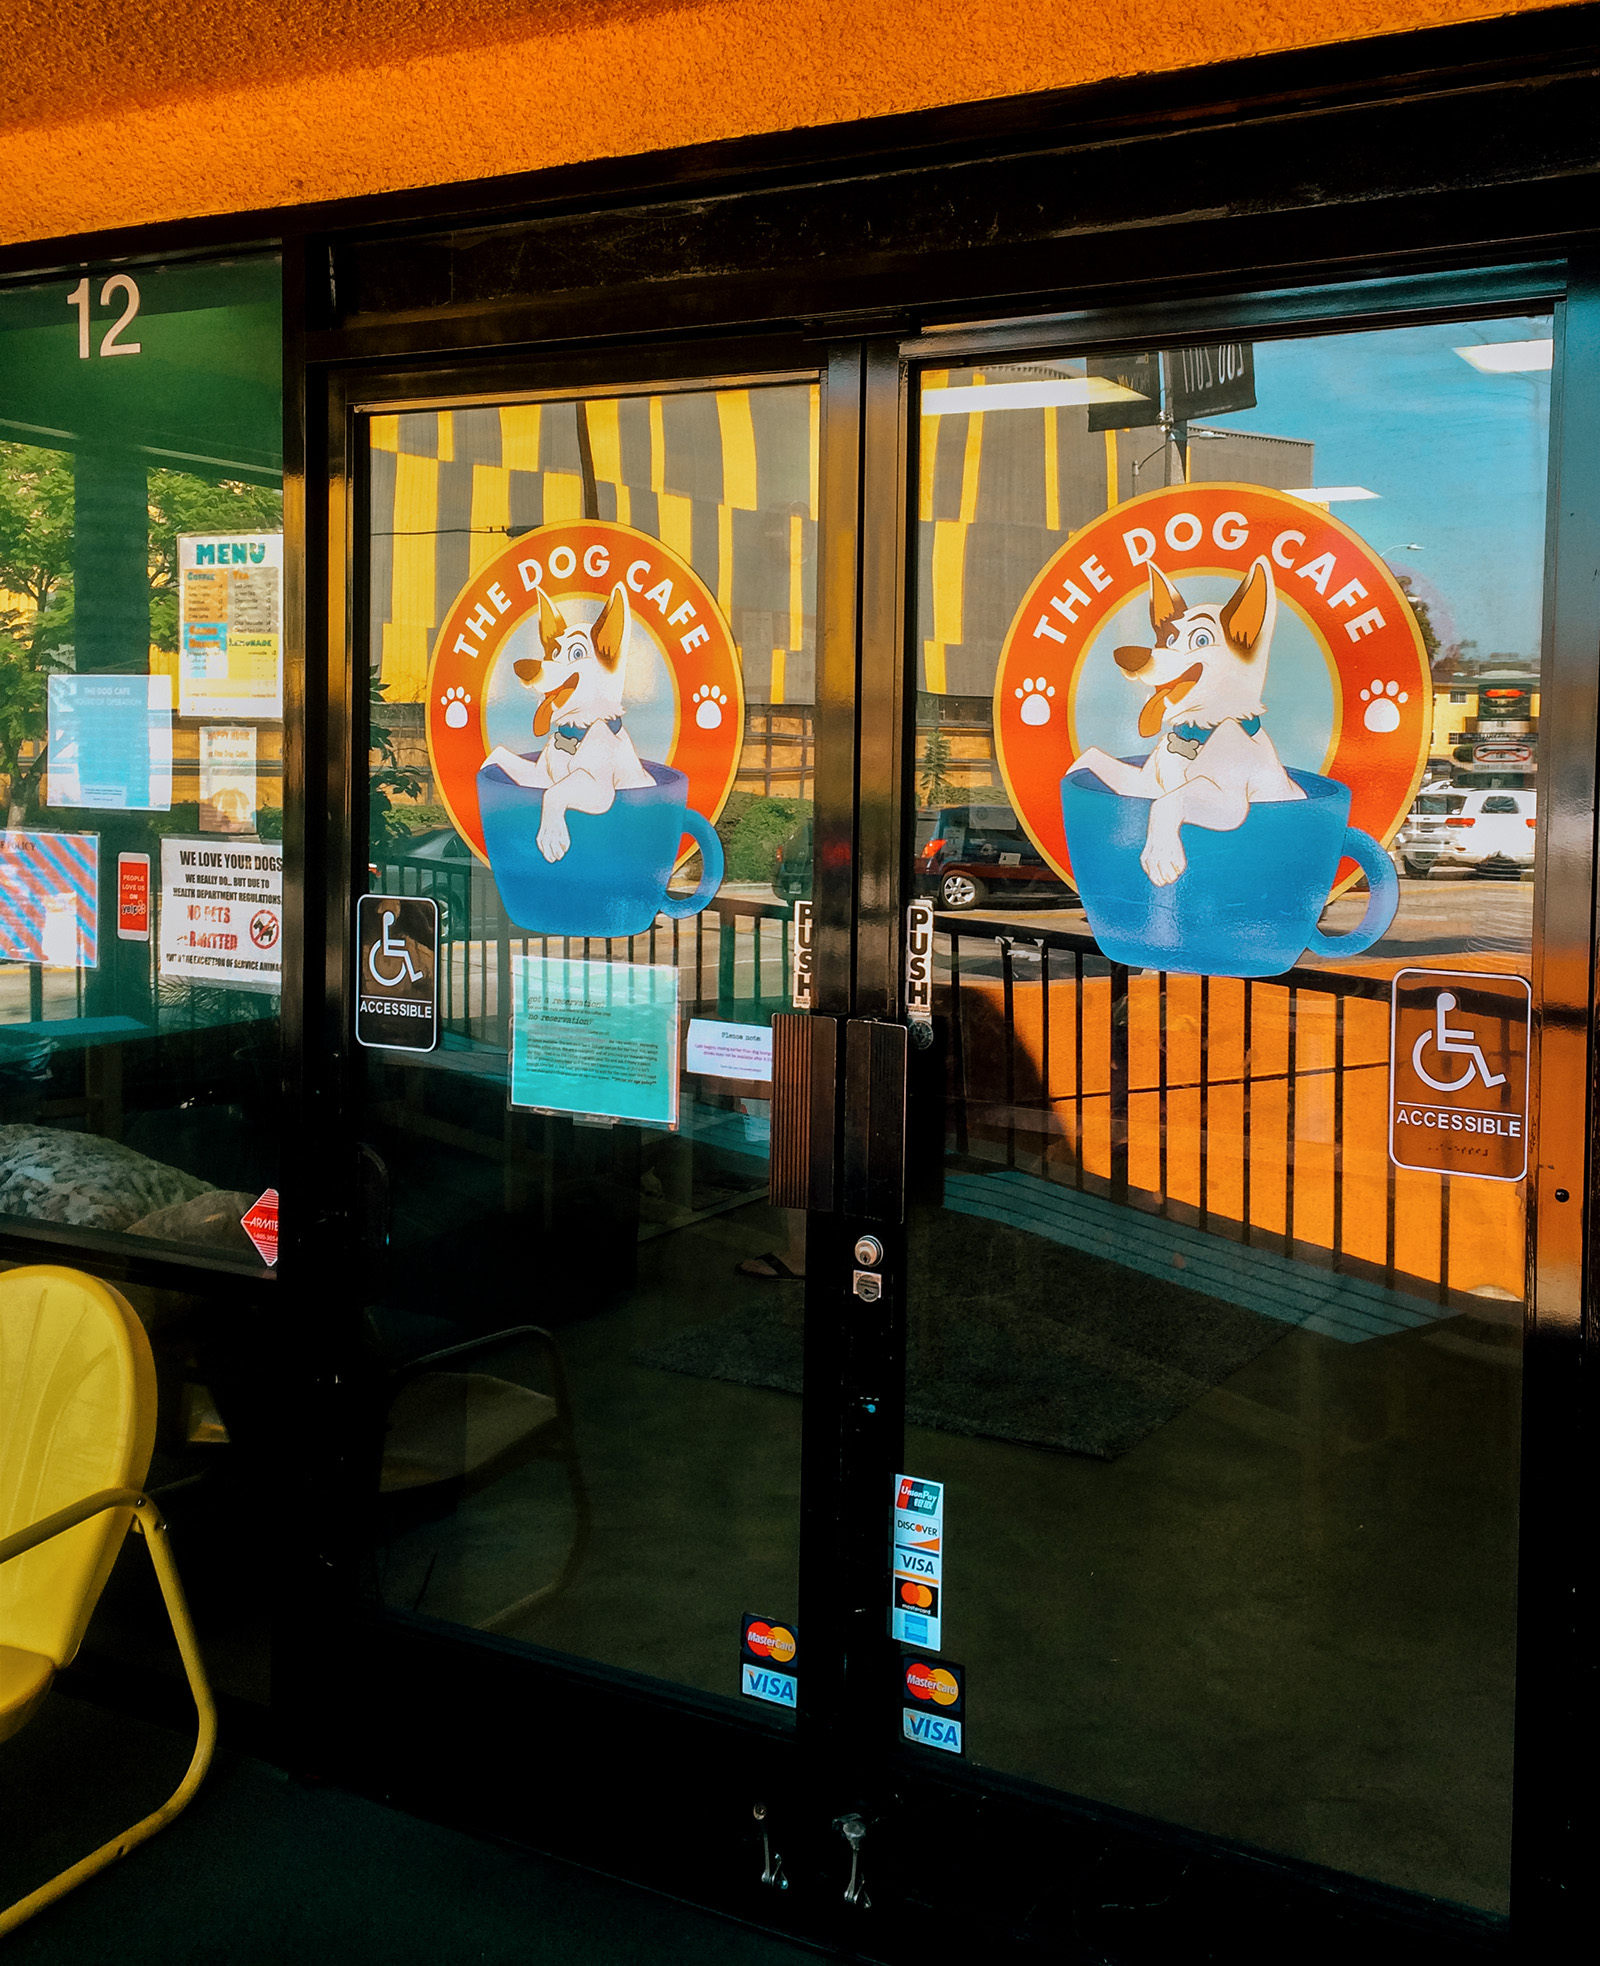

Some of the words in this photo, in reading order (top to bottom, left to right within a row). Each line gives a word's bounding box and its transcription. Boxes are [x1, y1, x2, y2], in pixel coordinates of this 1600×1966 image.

[67, 274, 141, 359] 12
[196, 543, 265, 565] MENU
[1032, 553, 1114, 646] THE
[1122, 511, 1249, 567] DOG
[1271, 529, 1387, 643] CAFE
[452, 581, 513, 660] THE
[517, 544, 610, 590] DOG
[625, 559, 711, 656] CAFE
[180, 851, 196, 866] WE
[198, 852, 222, 868] LOVE
[224, 854, 252, 870] YOUR
[254, 856, 283, 872] DOGS
[123, 874, 145, 882] PEOPLE
[185, 873, 196, 884] WE
[197, 874, 217, 885] REALLY
[233, 877, 246, 888] BUT
[248, 878, 260, 888] DUE
[261, 879, 270, 889] TO
[173, 887, 195, 898] HEALTH
[197, 889, 237, 901] DEPARTMENT
[798, 903, 813, 997] PUSH
[908, 908, 929, 1005] PUSH
[360, 1000, 432, 1019] ACCESSIBLE
[527, 996, 542, 1005] got
[528, 1013, 539, 1021] no
[721, 1031, 743, 1040] Please
[1397, 1109, 1521, 1138] ACCESSIBLE
[901, 1485, 938, 1502] UnionPay
[897, 1519, 937, 1536] DISCOVER
[900, 1553, 934, 1574] VISA
[747, 1631, 795, 1652] MasterCard
[747, 1669, 794, 1701] VISA
[906, 1672, 958, 1695] MasterCard
[907, 1713, 959, 1746] VISA
